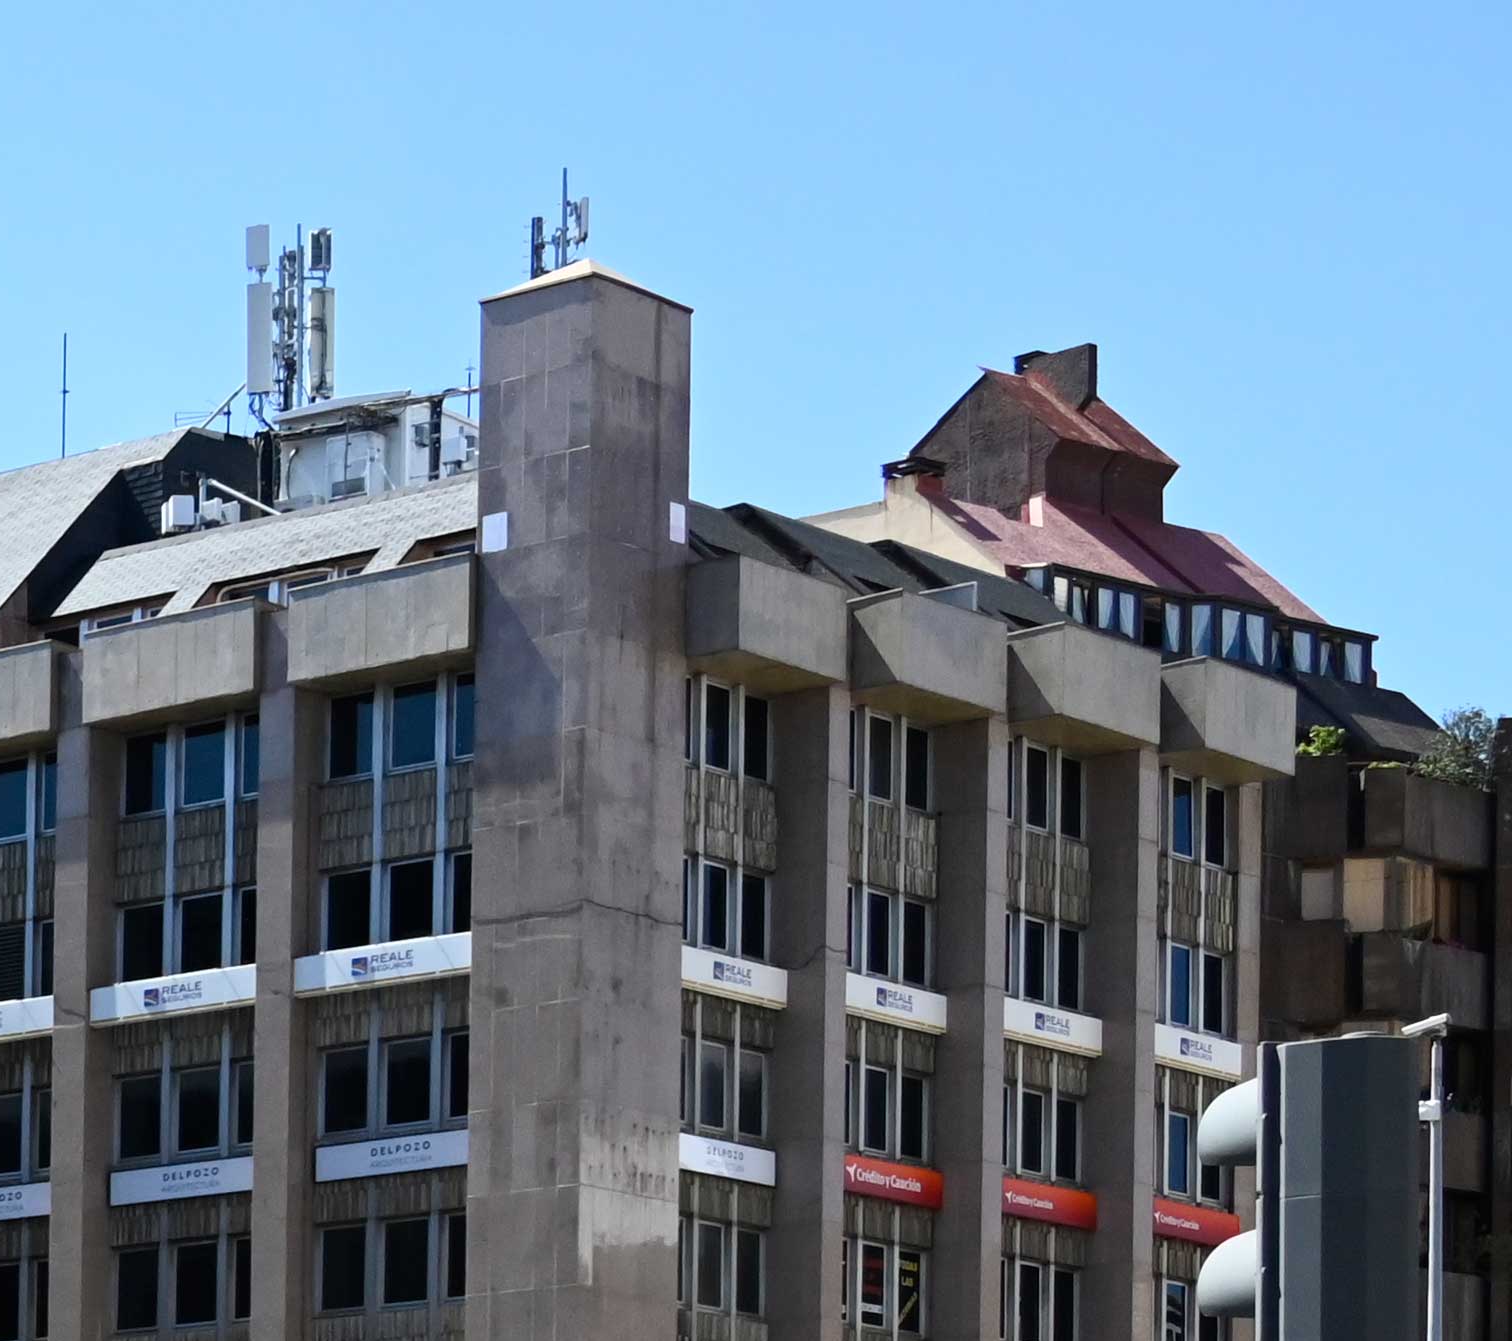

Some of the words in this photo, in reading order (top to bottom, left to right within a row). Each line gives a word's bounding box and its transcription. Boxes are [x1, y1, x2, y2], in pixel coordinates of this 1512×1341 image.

[369, 949, 414, 964] REALE
[725, 963, 752, 979] REALE
[161, 980, 203, 995] REALE
[887, 989, 913, 1004] REALE
[1046, 1015, 1070, 1029] REALE
[370, 1140, 431, 1157] DELPOZO
[162, 1166, 220, 1183] DELPOZO
[856, 1170, 885, 1186] Crédito
